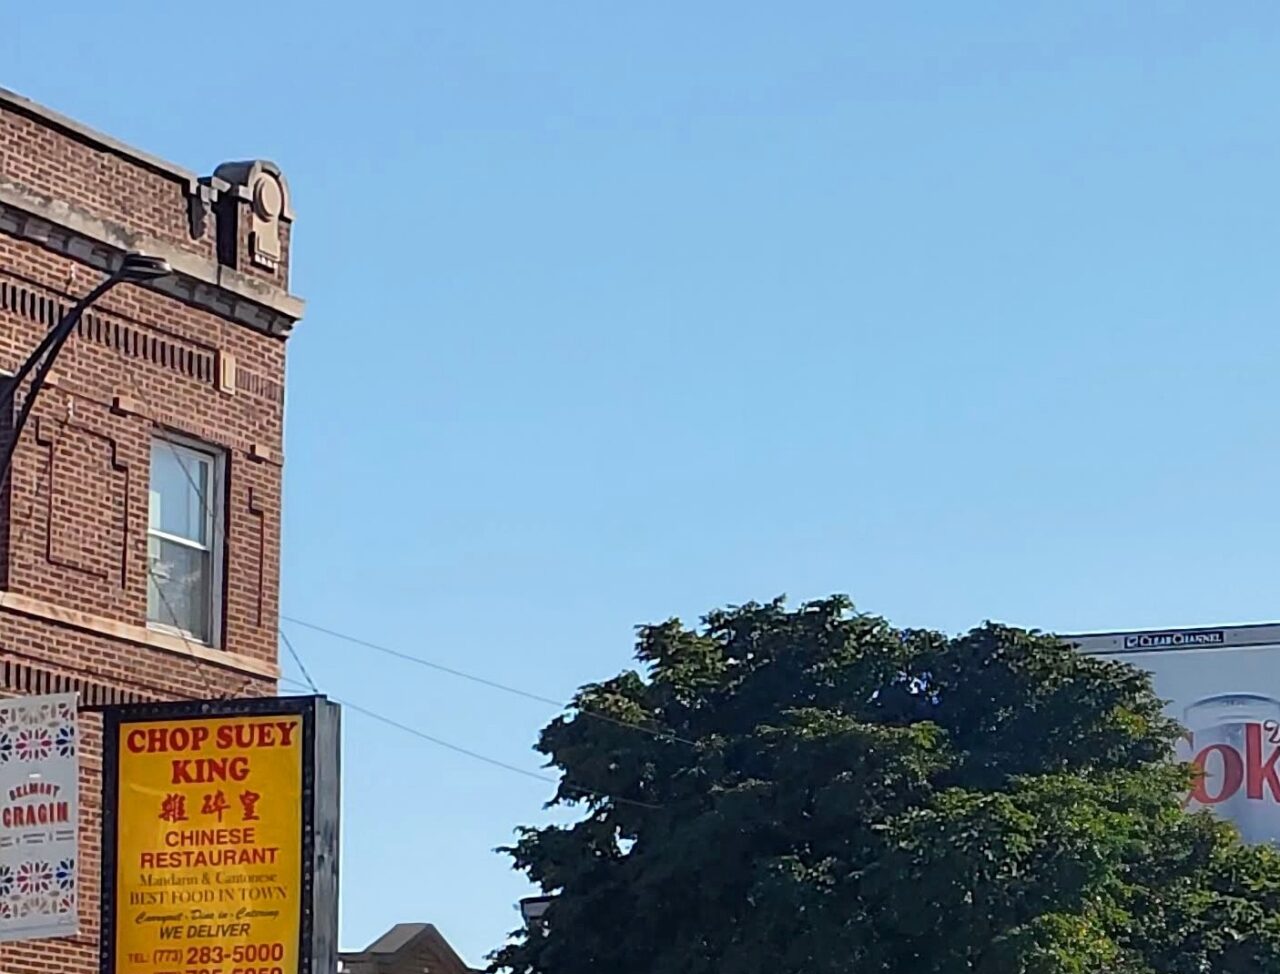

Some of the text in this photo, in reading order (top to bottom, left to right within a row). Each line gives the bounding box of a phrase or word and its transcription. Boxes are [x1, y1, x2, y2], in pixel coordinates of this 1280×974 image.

[127, 721, 298, 753] CHOP SUEY
[171, 757, 250, 785] KING
[2, 801, 69, 828] CRAGIN
[165, 828, 255, 848] CHINESE
[140, 847, 279, 869] RESTAURANT
[139, 871, 277, 886] Mandarin & Cantonese
[130, 886, 288, 905] BEST FOOD IN TOWN
[159, 922, 251, 940] WE DELIVER
[153, 949, 183, 965] (773)
[186, 943, 284, 965] 283-5000
